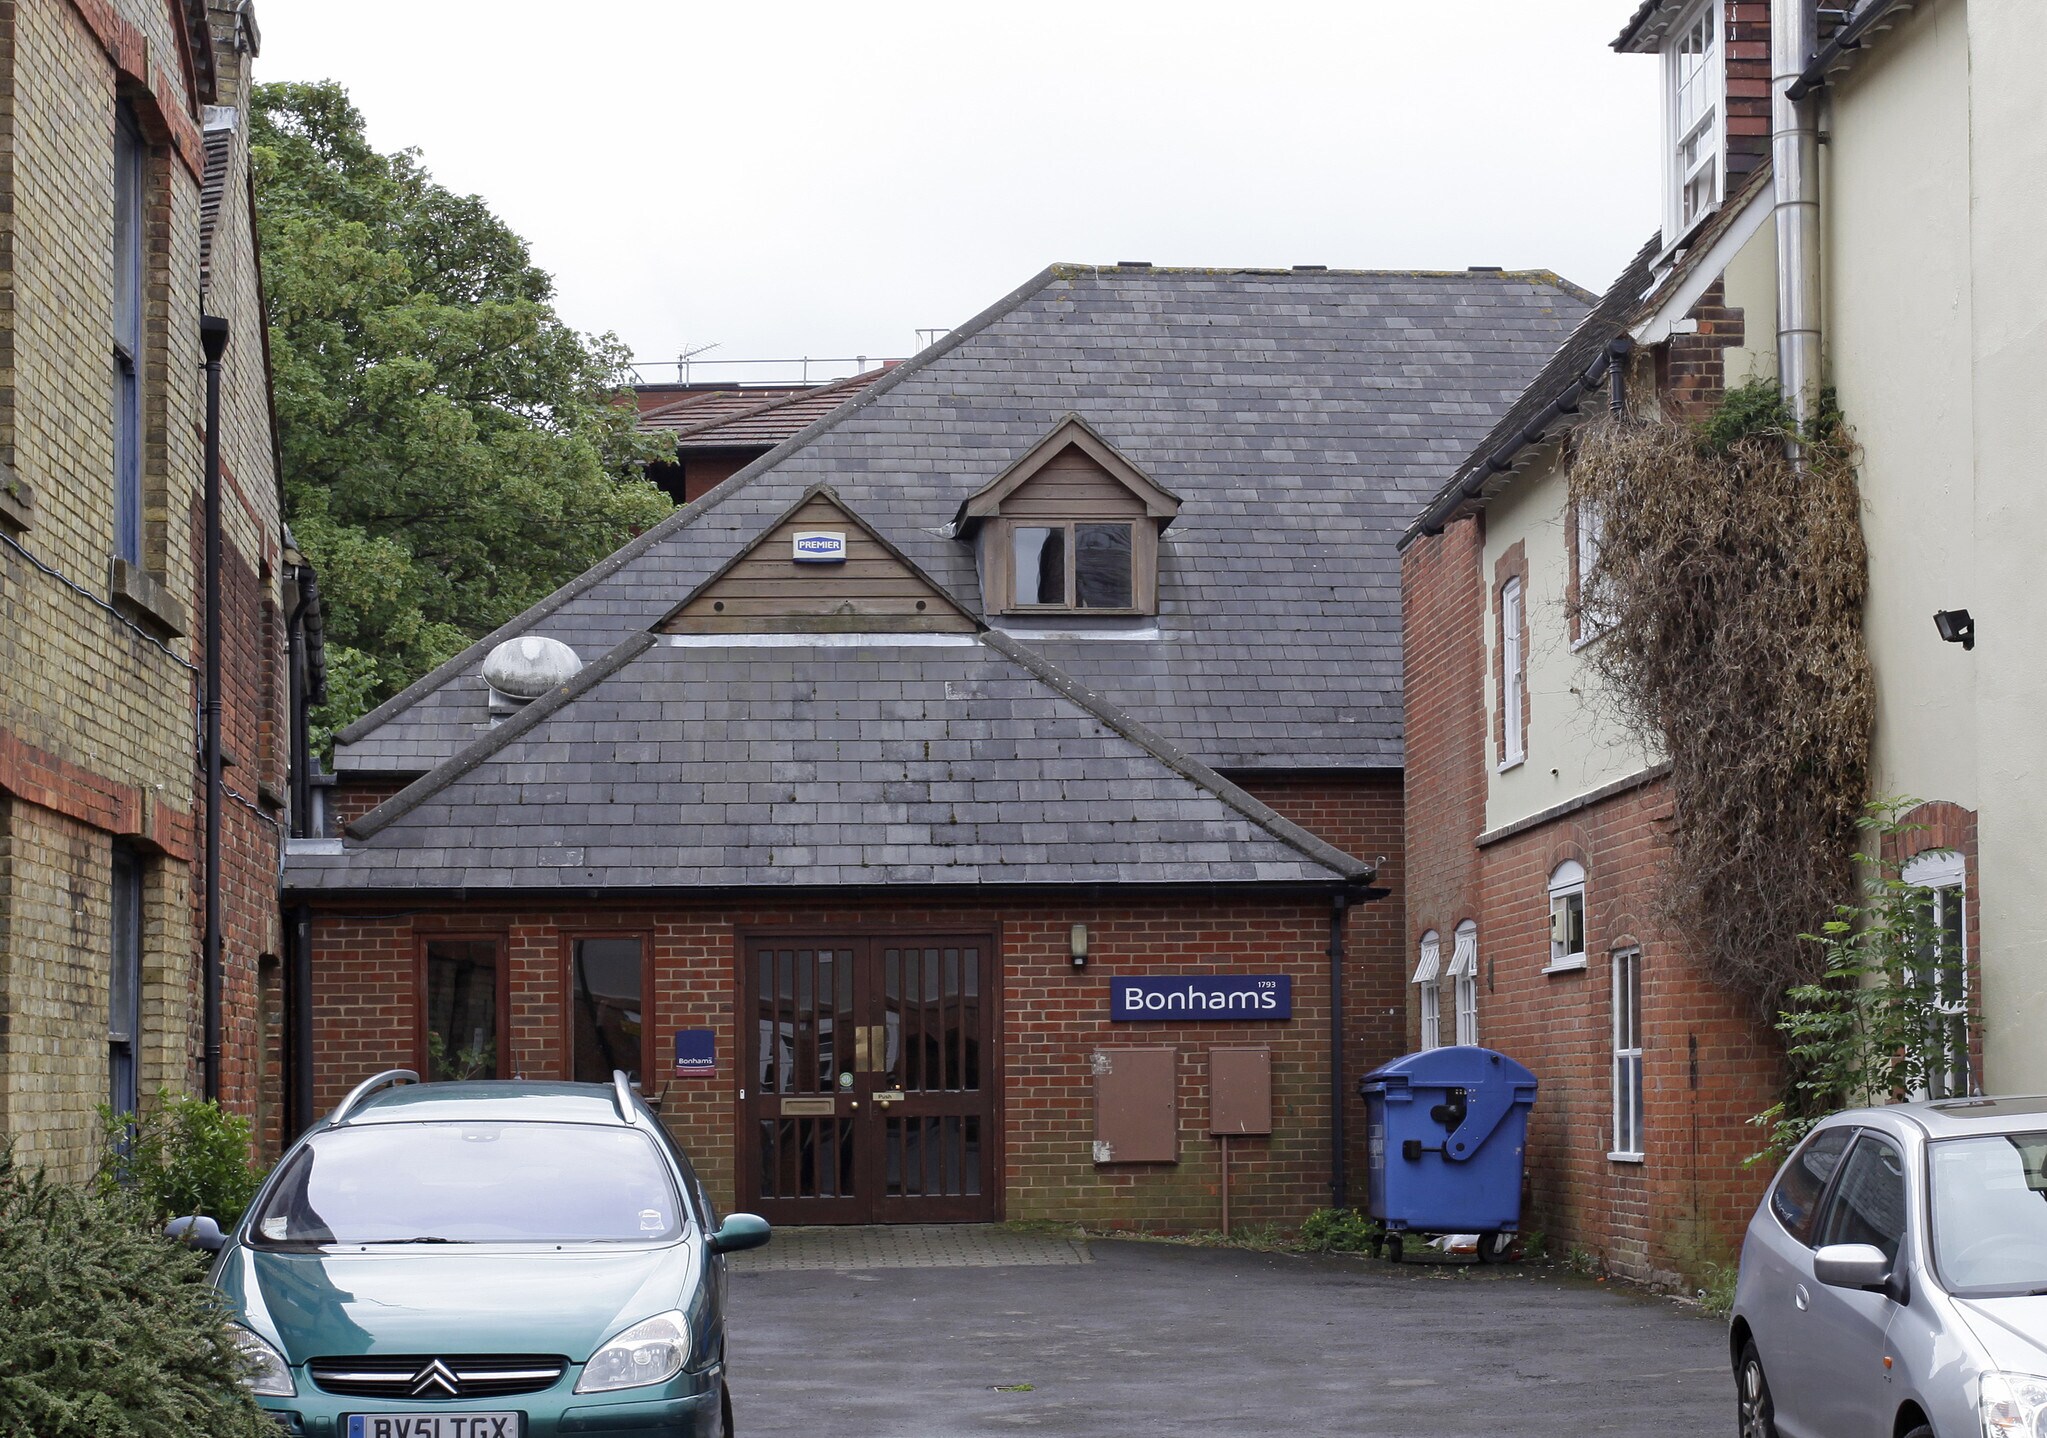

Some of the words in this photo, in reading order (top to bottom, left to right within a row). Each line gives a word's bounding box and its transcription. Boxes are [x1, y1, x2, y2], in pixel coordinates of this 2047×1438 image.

[799, 541, 840, 549] PREMIER
[1125, 985, 1277, 1010] Bonhams
[450, 1418, 508, 1438] TGX
